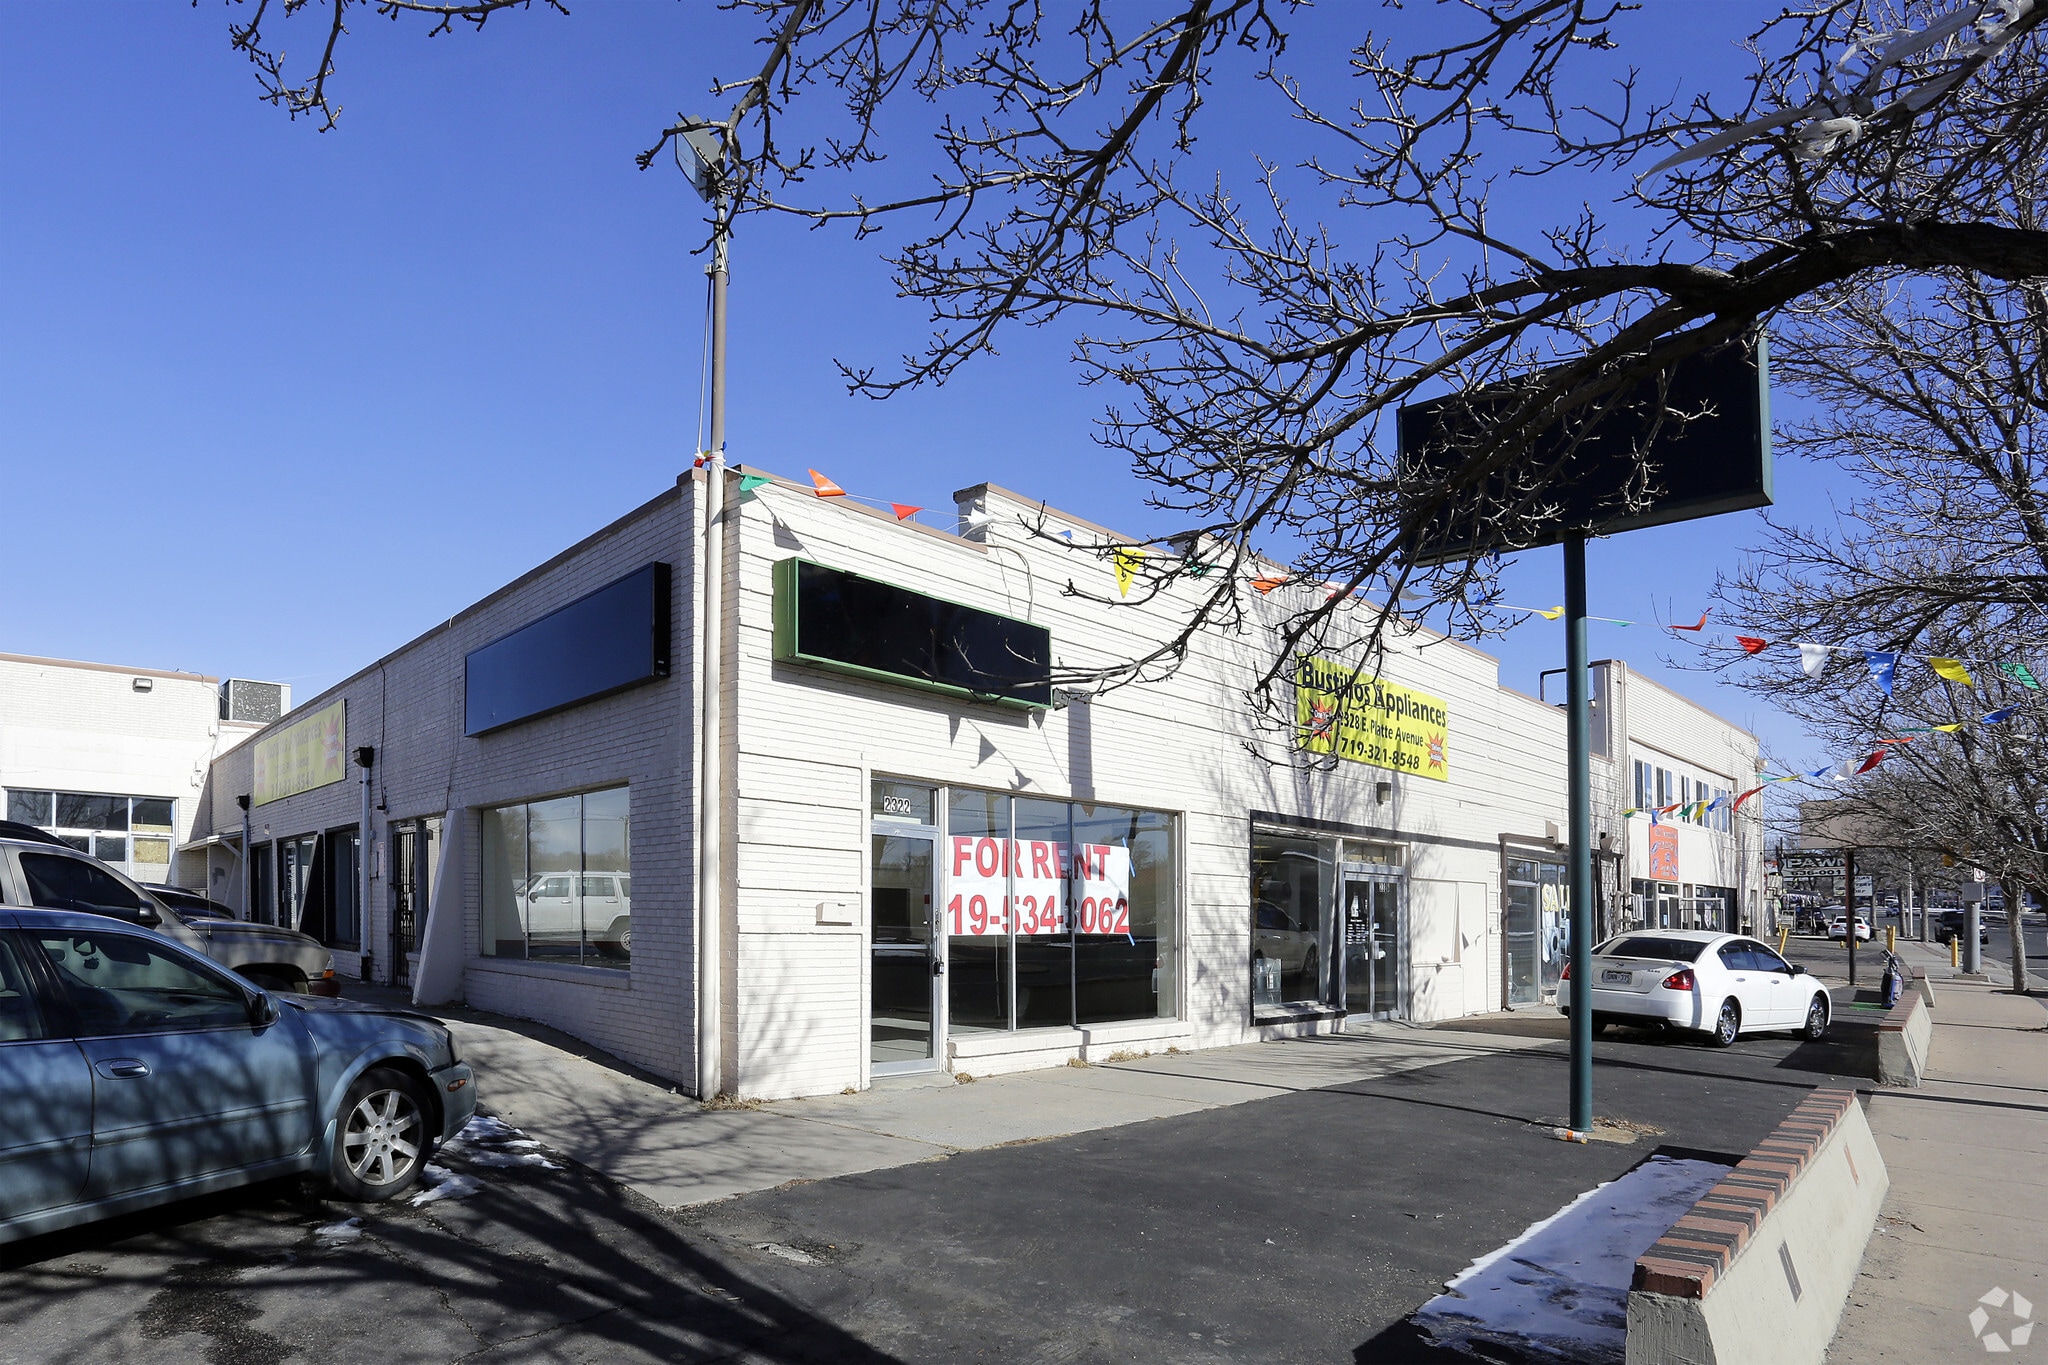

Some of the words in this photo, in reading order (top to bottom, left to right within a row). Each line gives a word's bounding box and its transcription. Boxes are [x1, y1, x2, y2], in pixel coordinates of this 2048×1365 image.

[1373, 684, 1446, 728] Appliances
[1371, 720, 1394, 740] Platte
[1395, 726, 1424, 748] Avenue
[1341, 737, 1420, 770] 719-321-8548
[884, 797, 910, 814] 2322
[952, 836, 1023, 878] FOR
[1031, 841, 1111, 881] RENT
